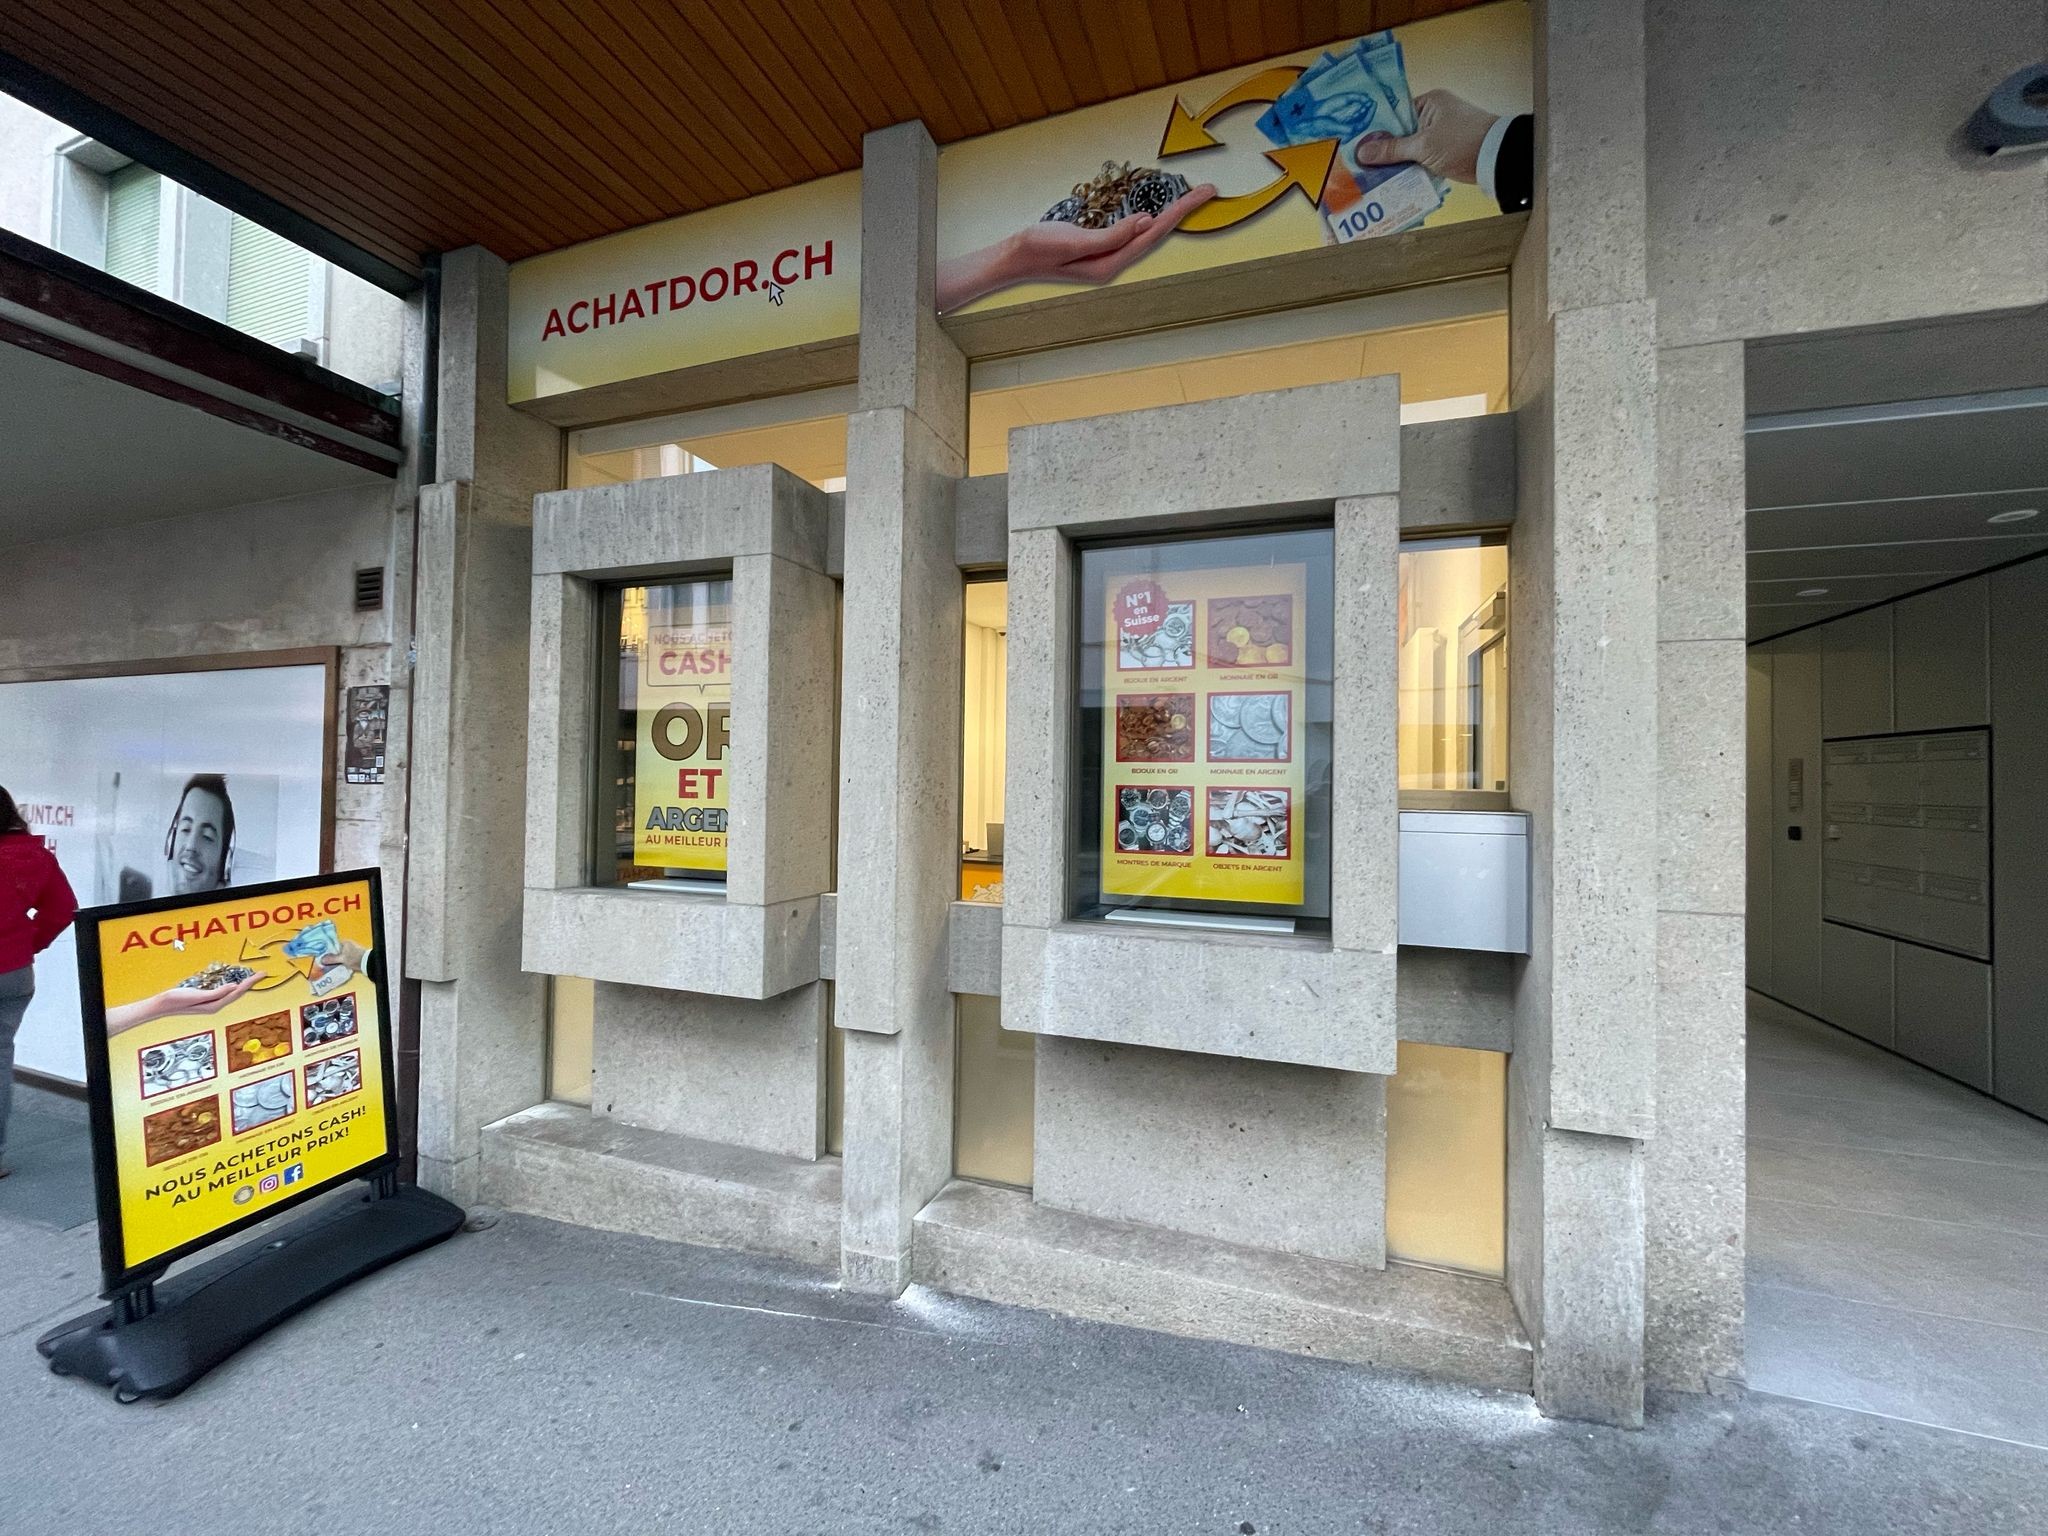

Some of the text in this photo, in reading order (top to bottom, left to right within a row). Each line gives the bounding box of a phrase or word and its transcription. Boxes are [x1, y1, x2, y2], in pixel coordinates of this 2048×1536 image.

[1338, 202, 1385, 238] 100
[541, 240, 833, 341] ACHATDOR.CH
[1124, 614, 1160, 627] Suisse
[1133, 606, 1148, 615] en
[678, 768, 723, 799] ET
[26, 803, 74, 827] UNT.CH
[645, 834, 661, 845] AU
[664, 835, 721, 848] MEILLEUR
[1161, 861, 1192, 869] MARQUE
[1213, 863, 1240, 871] OBJETS
[1253, 865, 1283, 873] ARGENT
[121, 893, 361, 953] ACHATDOR.CH
[145, 1168, 206, 1200] NOUS
[213, 1128, 313, 1174] ACHETONS
[318, 1105, 367, 1132] CASH!
[172, 1188, 201, 1208] AU
[208, 1147, 302, 1192] MEILLEUR
[307, 1127, 350, 1152] PRIX!
